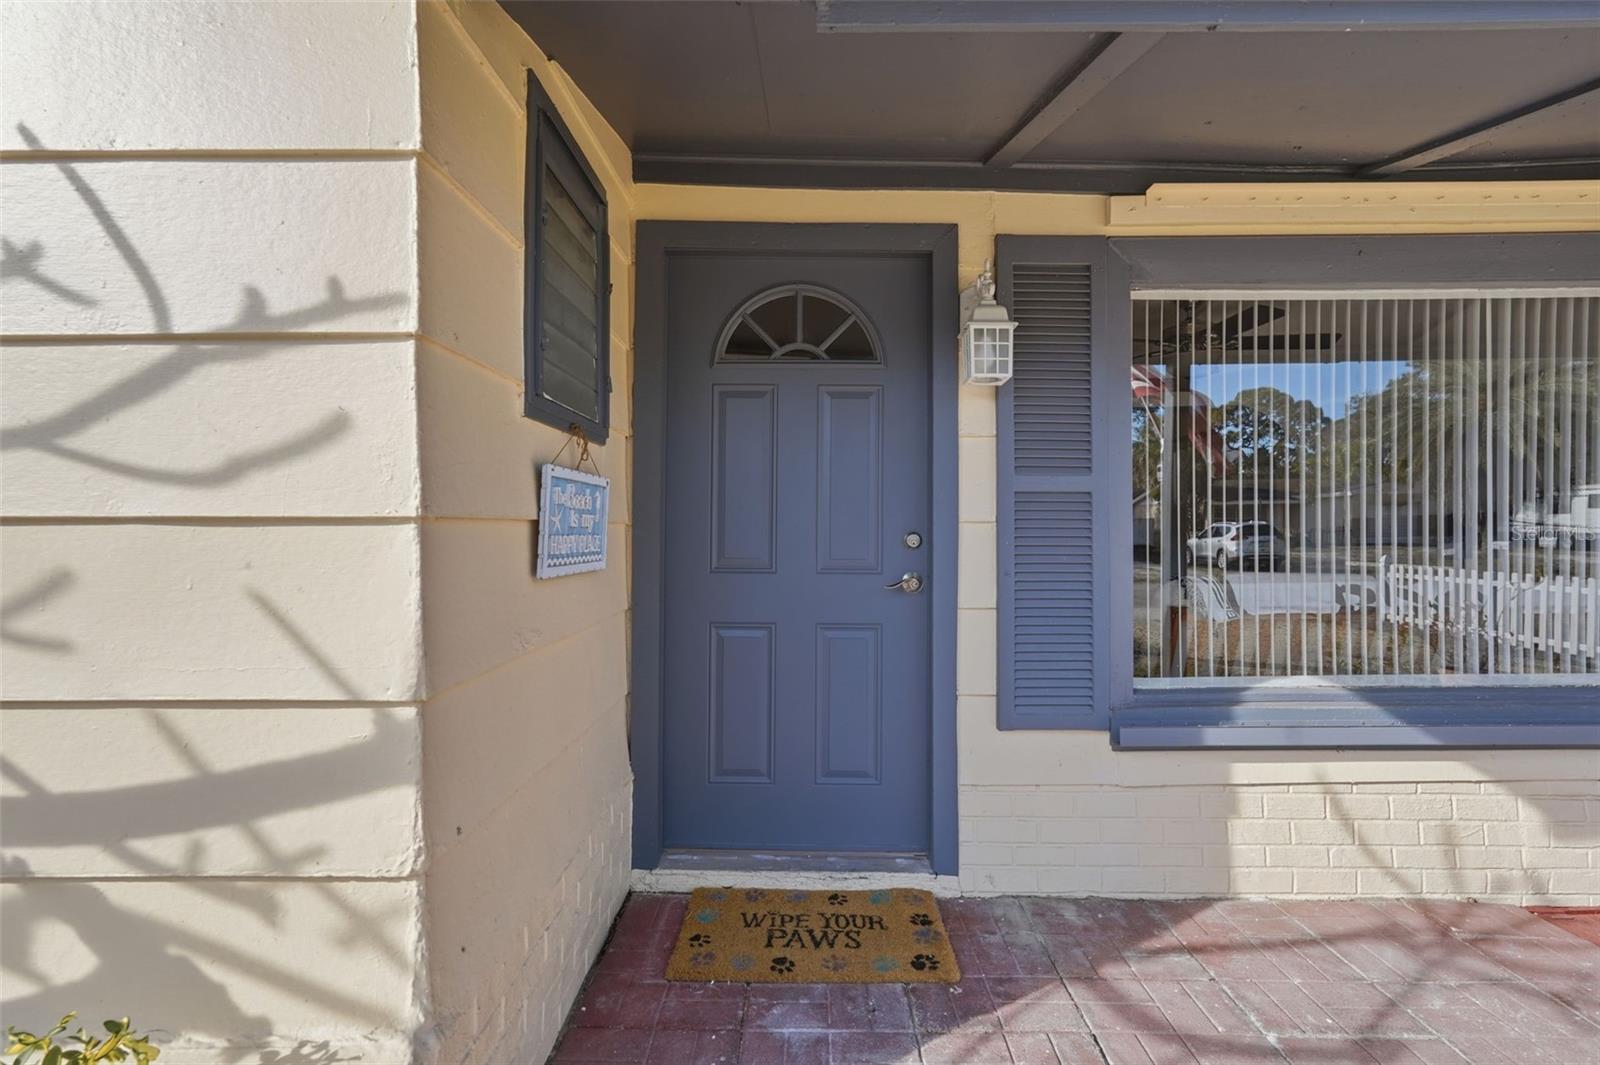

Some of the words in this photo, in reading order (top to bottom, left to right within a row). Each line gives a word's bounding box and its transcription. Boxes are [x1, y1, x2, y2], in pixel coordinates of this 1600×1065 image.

[581, 514, 594, 533] my
[817, 911, 889, 931] YOUR
[764, 928, 862, 950] PAWS
